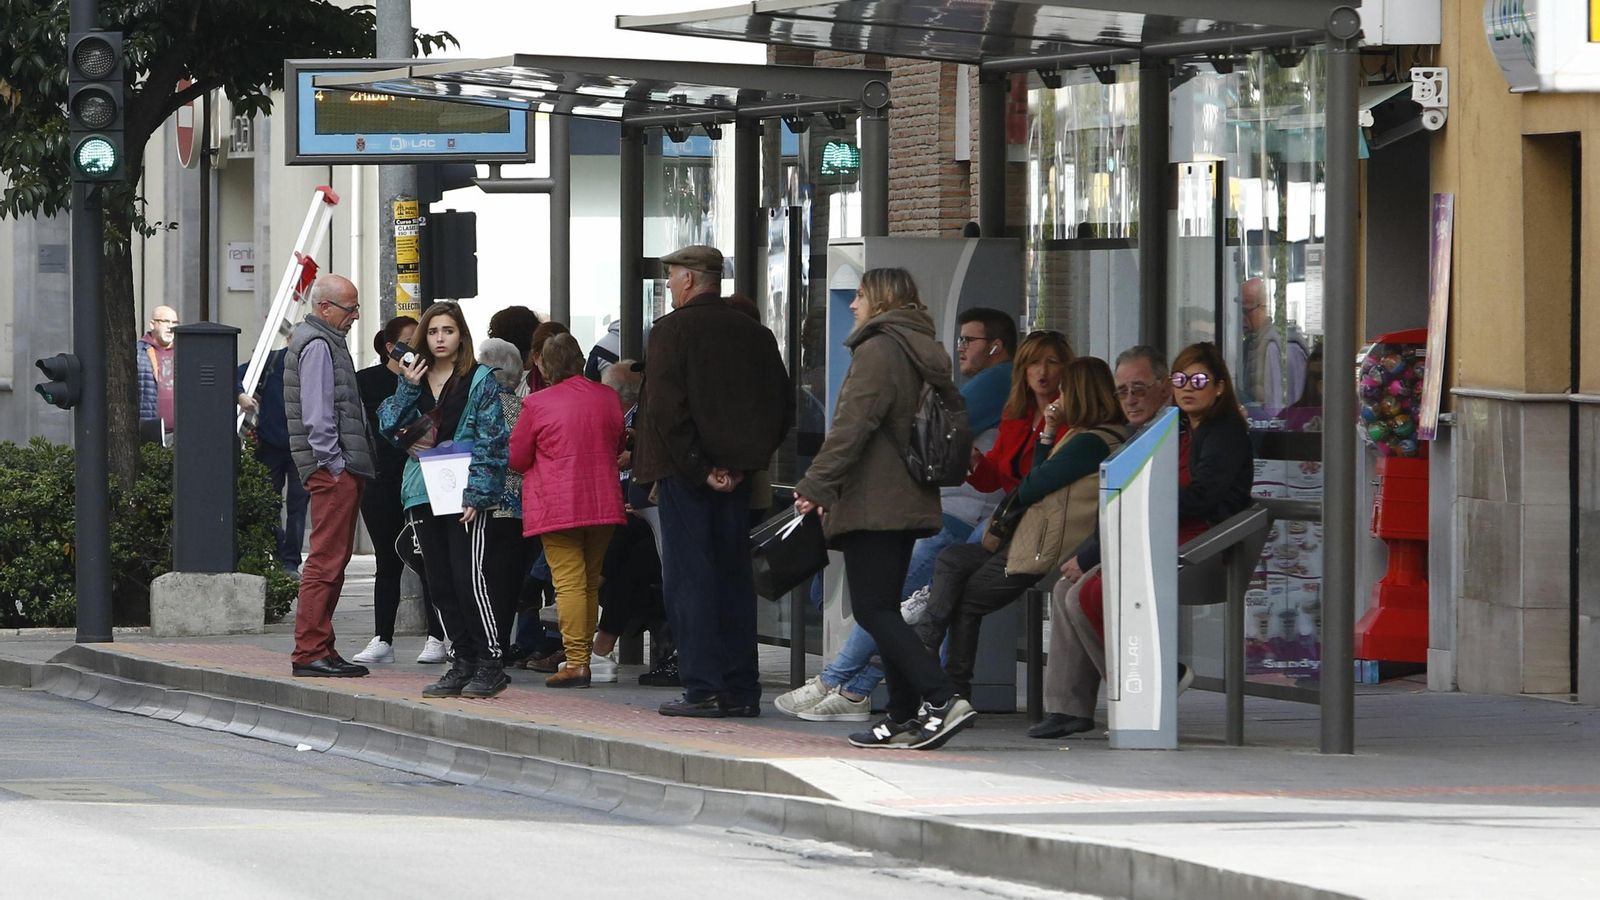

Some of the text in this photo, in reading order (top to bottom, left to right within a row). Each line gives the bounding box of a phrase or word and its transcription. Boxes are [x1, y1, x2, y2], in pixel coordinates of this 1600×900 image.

[314, 90, 324, 101] 4
[411, 139, 436, 148] LAC
[229, 247, 255, 260] rent
[1128, 635, 1138, 666] LAC
[1262, 659, 1321, 670] Sandy
[924, 716, 943, 732] N
[872, 724, 892, 740] N
